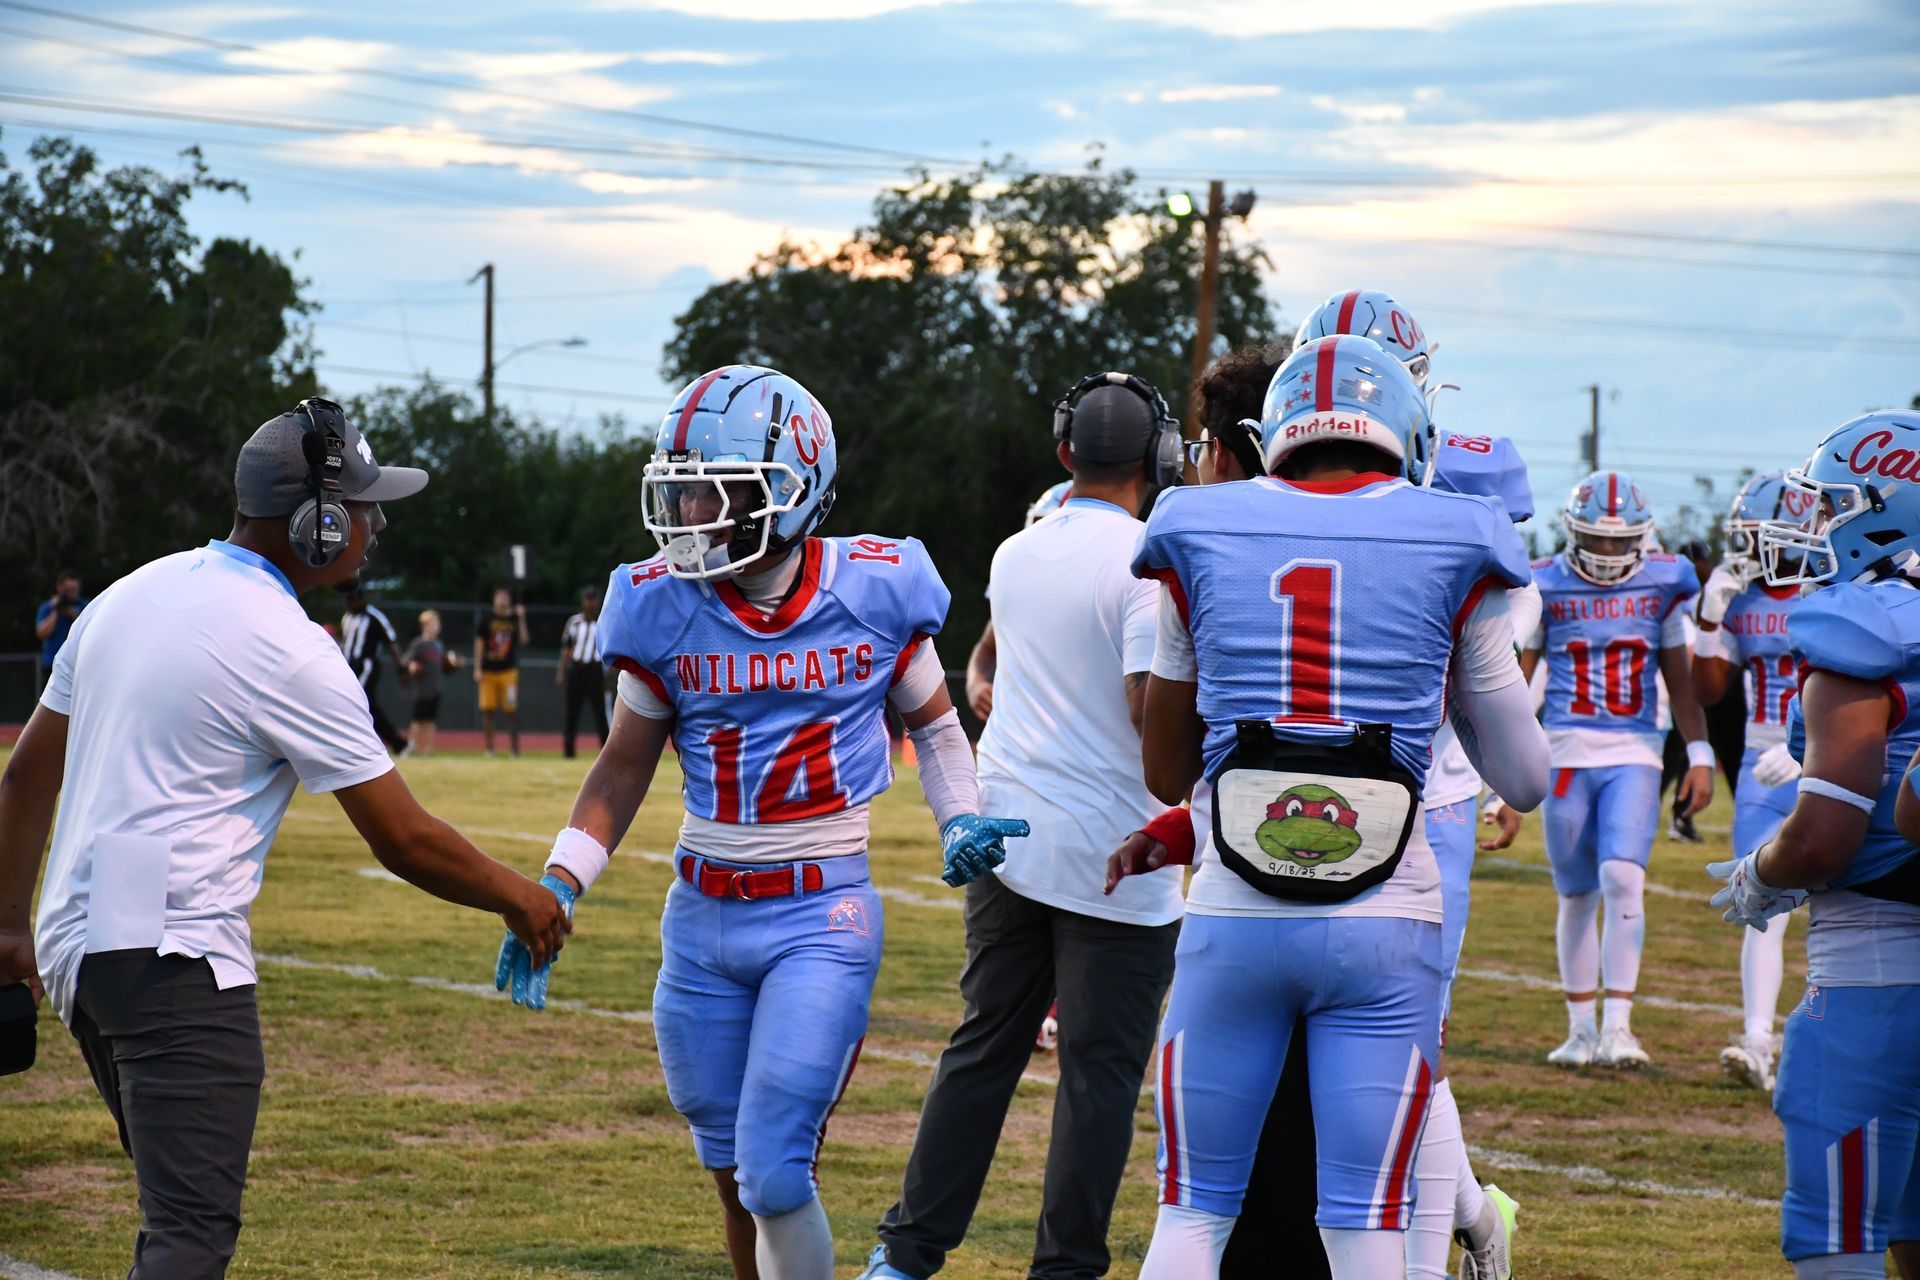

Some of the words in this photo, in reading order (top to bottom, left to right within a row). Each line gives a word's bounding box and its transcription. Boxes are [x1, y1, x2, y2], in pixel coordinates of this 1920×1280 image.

[1286, 417, 1369, 440] Riddell
[1849, 429, 1920, 484] Ca
[510, 544, 526, 579] 1
[845, 535, 903, 567] 14
[1548, 596, 1662, 622] WILDCATS
[1732, 612, 1789, 635] WILDC
[1270, 557, 1357, 730] 1
[675, 642, 873, 695] WILDCATS
[1564, 634, 1651, 718] 10
[703, 715, 854, 825] 14
[1268, 861, 1317, 878] 9/18/25
